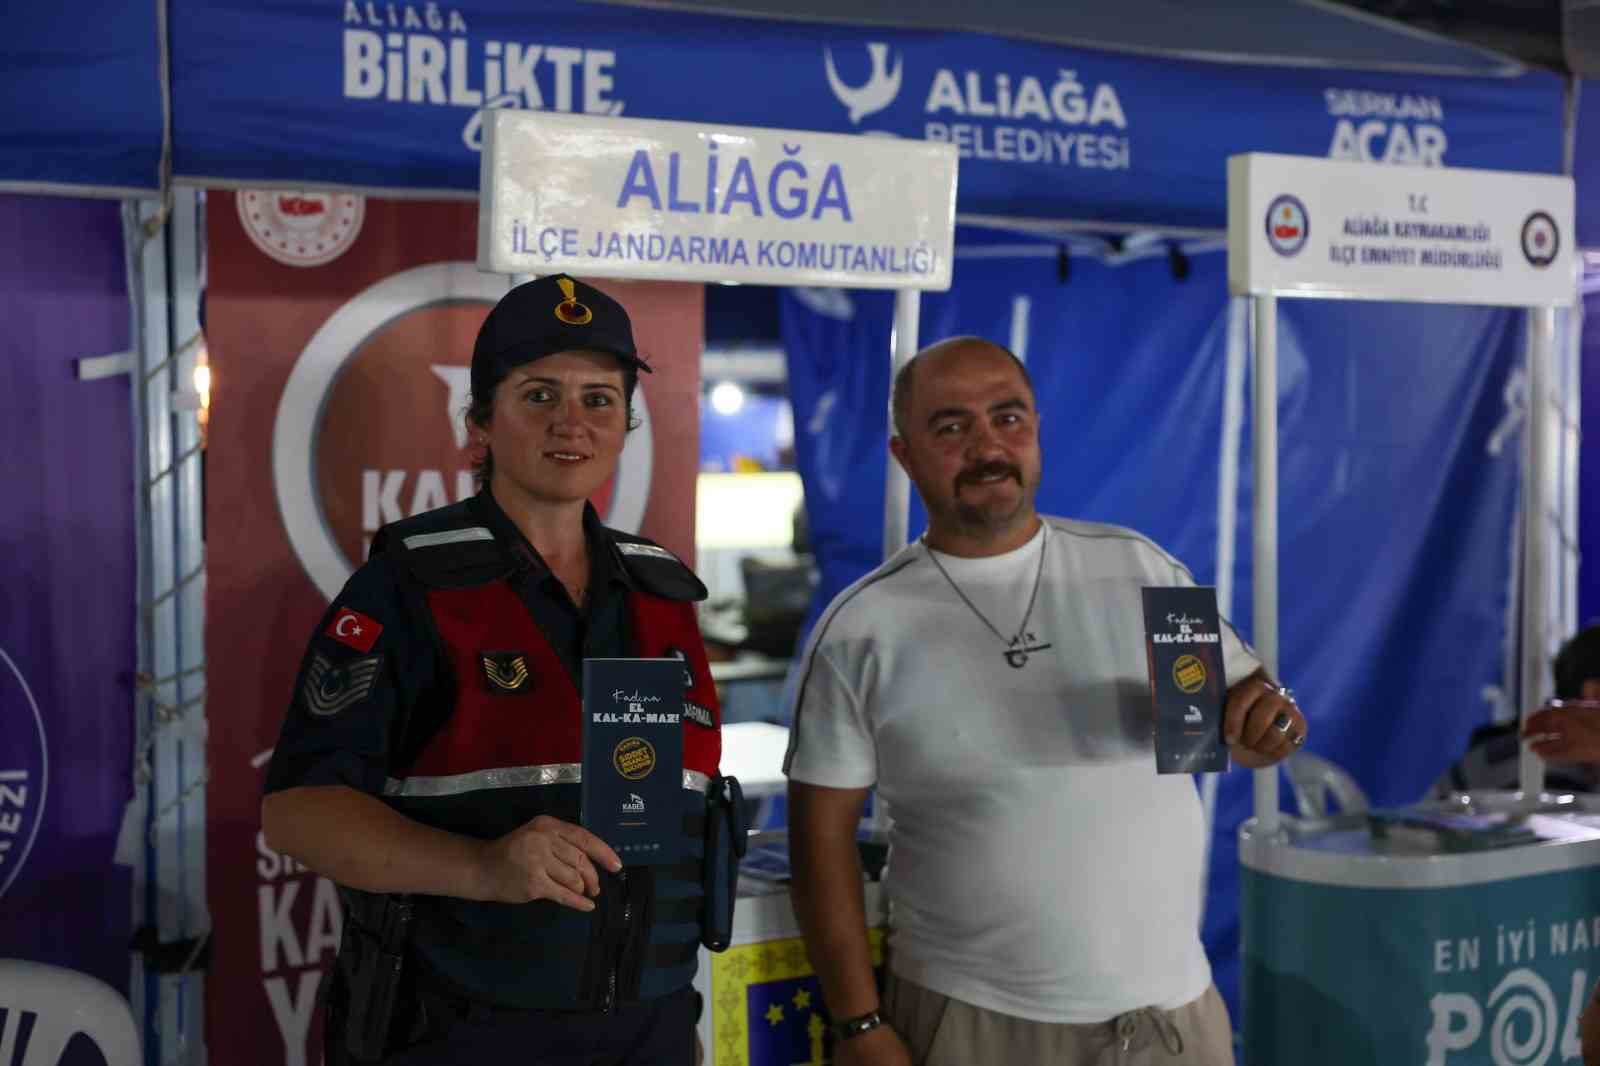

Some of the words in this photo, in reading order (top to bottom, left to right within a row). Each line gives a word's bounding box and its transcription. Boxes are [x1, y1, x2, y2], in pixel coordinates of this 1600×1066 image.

[1328, 118, 1448, 169] ACAR
[616, 140, 852, 223] ALİAĞA
[511, 219, 578, 263] İLÇE
[587, 231, 749, 266] JANDARMA
[757, 238, 938, 275] KOMUTANLIĞI
[592, 712, 680, 723] KAL-KA-MAZ!
[629, 702, 645, 713] EL
[1434, 936, 1480, 972] EN
